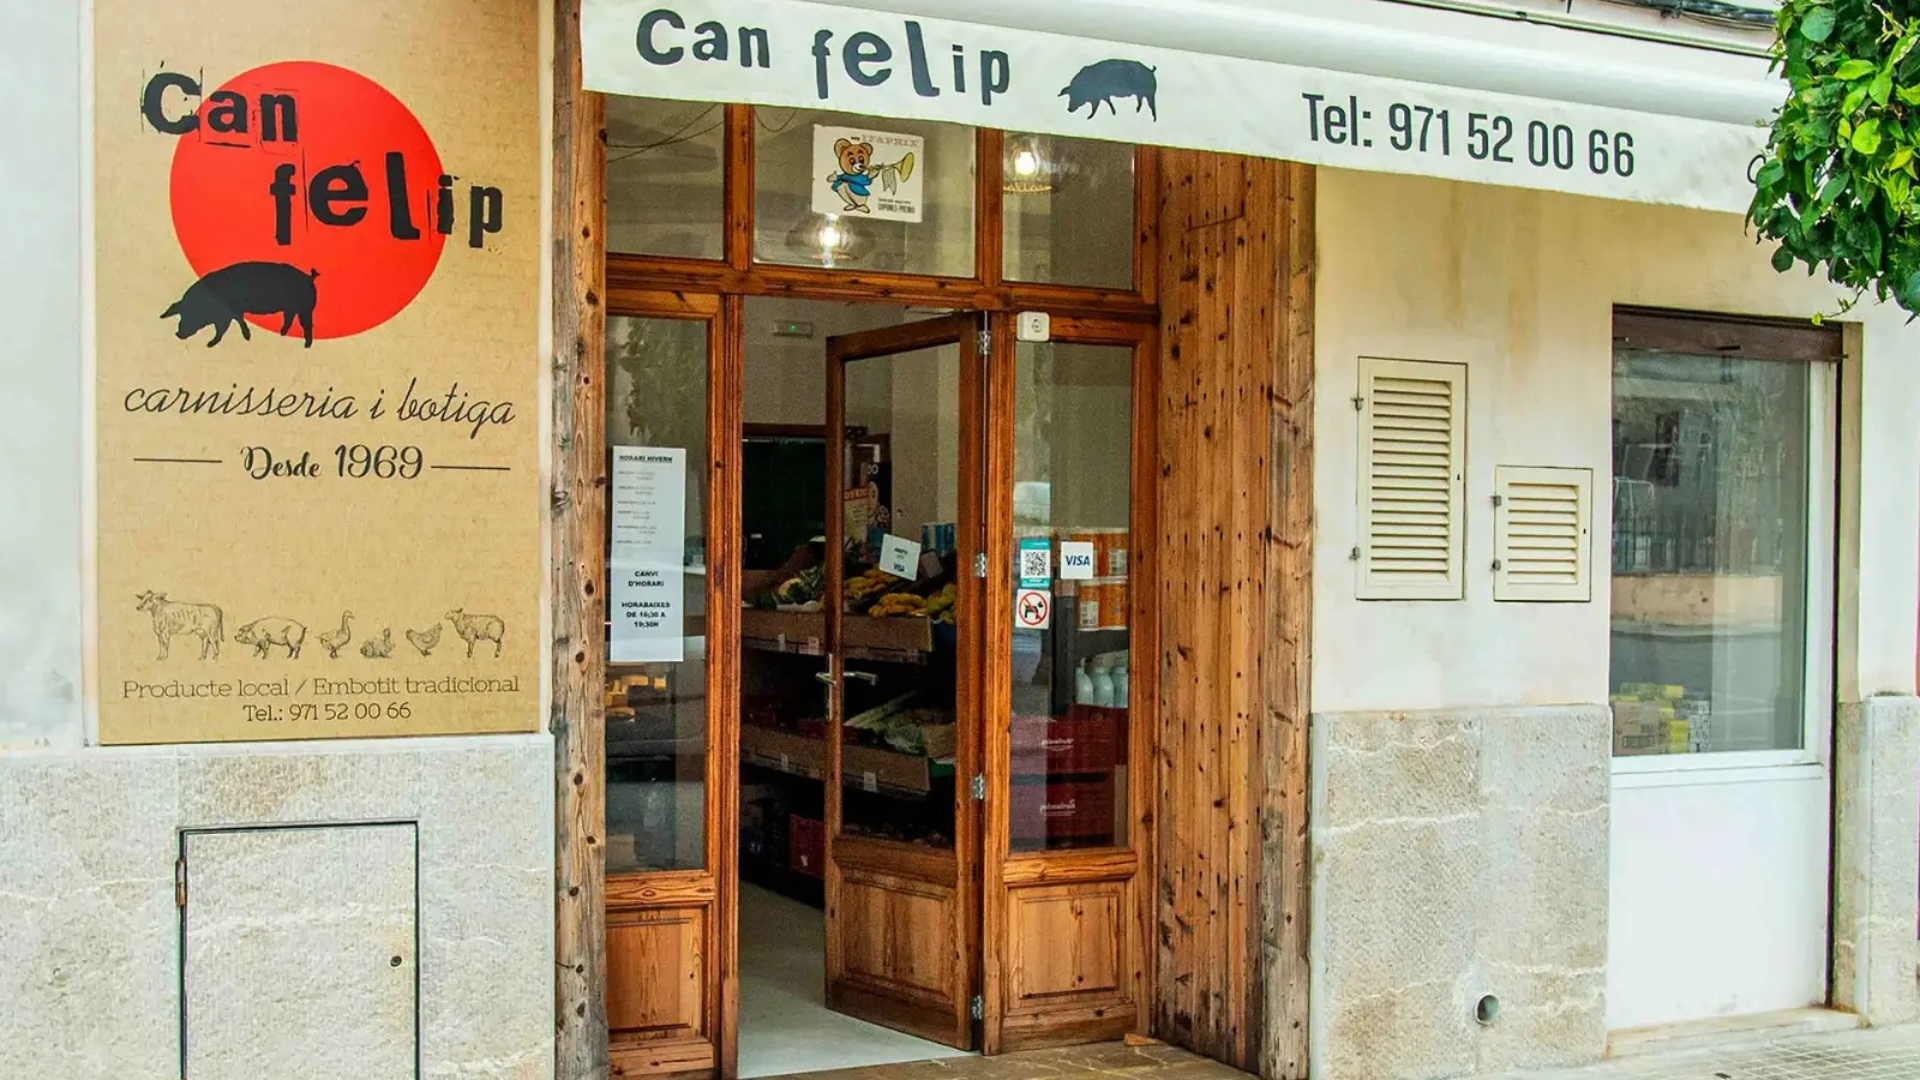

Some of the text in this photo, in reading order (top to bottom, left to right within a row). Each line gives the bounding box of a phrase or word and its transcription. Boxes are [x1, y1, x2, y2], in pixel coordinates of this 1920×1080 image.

[637, 9, 1010, 105] Can felip
[141, 71, 297, 143] Can
[1302, 93, 1634, 177] Tel: 971 52 00 66
[270, 152, 503, 248] felip
[124, 377, 516, 439] carnisseria i botiga
[240, 444, 424, 480] Desde 1969
[1065, 555, 1091, 566] VISA
[123, 679, 233, 699] Producte
[238, 678, 289, 697] local
[313, 677, 400, 696] Embotit
[405, 675, 520, 694] tradicional
[242, 702, 412, 722] Tel.: 971 52 00 66
